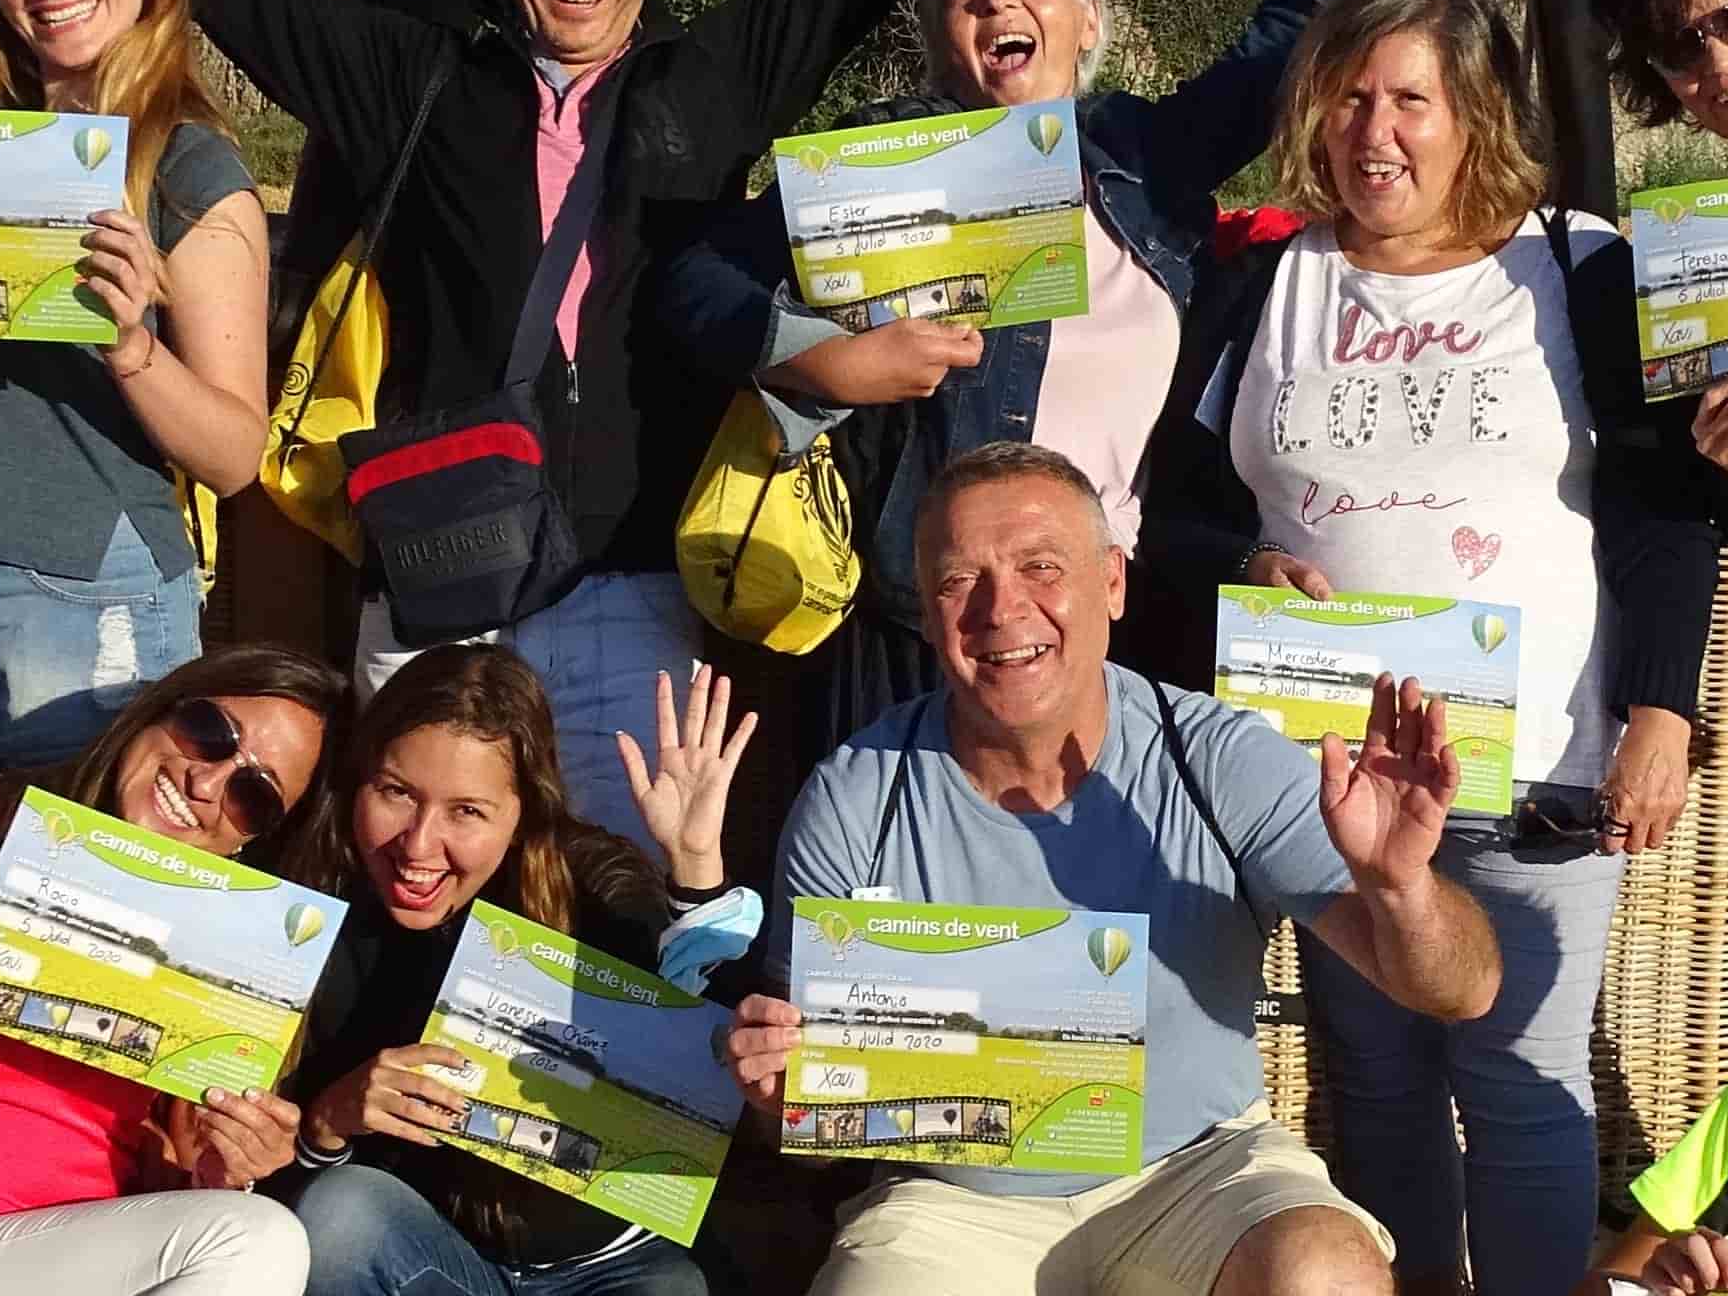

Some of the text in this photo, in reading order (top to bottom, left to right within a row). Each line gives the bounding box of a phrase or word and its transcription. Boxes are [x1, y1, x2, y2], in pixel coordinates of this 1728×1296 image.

[840, 123, 971, 158] camins de vent
[828, 205, 871, 223] Ester
[901, 229, 934, 245] 2020
[1333, 305, 1483, 364] love
[1272, 366, 1512, 456] LOVE
[1301, 481, 1468, 526] love
[1283, 596, 1415, 620] camins de vent
[87, 827, 231, 892] camins de vent
[867, 915, 1020, 941] camins de vent
[530, 940, 660, 1006] camins de vent
[487, 991, 547, 1029] Vanessa
[846, 982, 907, 1009] Antonio
[841, 1028, 851, 1045] 5
[903, 1034, 943, 1050] 2020
